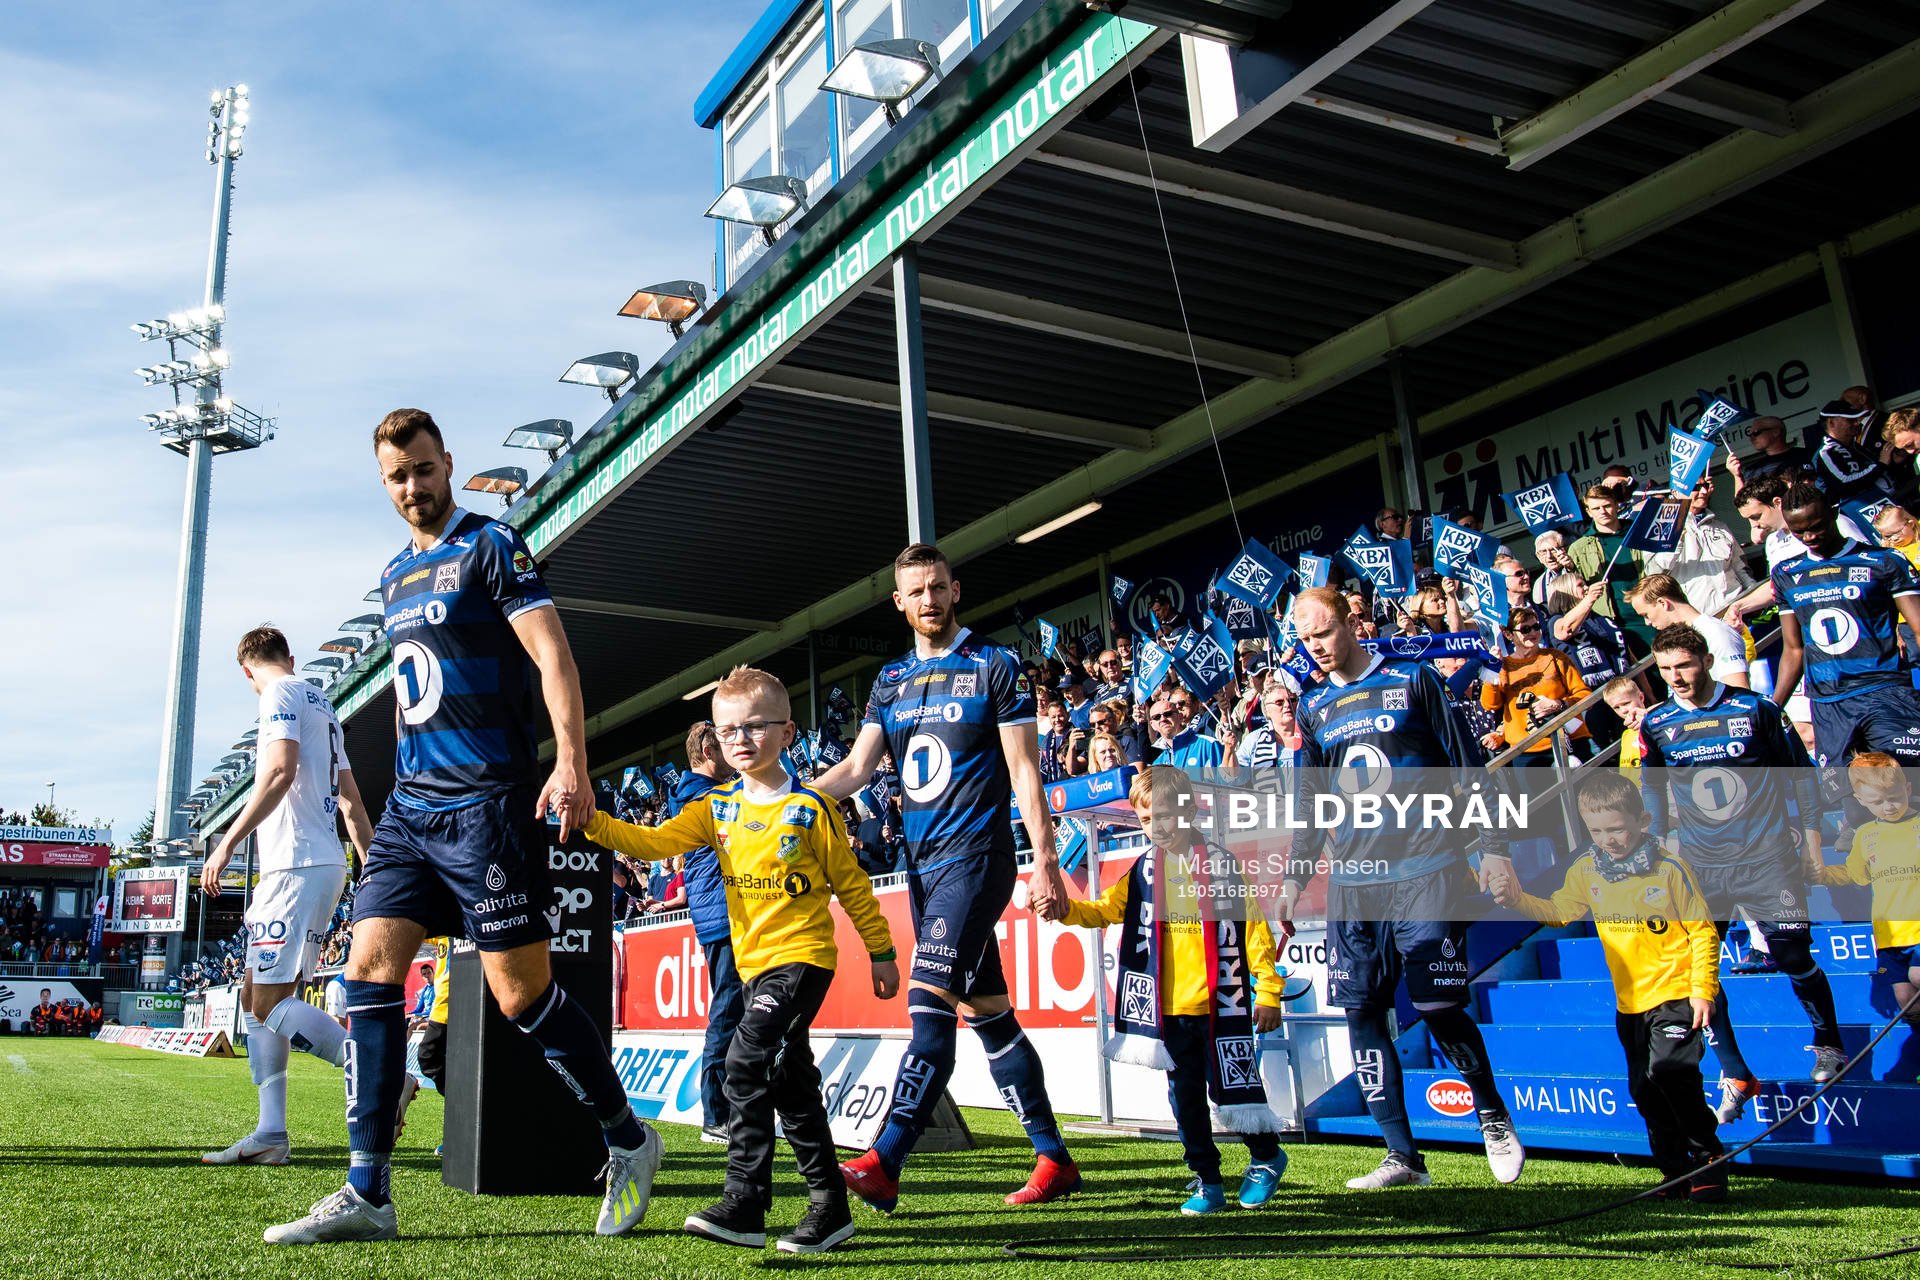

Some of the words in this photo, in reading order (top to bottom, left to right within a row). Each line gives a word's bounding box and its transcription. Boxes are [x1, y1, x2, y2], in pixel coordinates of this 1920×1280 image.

[540, 499, 573, 545] notar
[578, 462, 617, 509] notar
[621, 415, 667, 477] notar
[671, 364, 724, 435] notar
[731, 301, 793, 384] notar
[801, 228, 874, 324] notar
[886, 139, 974, 252] notar
[990, 26, 1103, 163] notar
[1516, 418, 1626, 488] Multi
[1518, 483, 1553, 507] KBK
[1658, 505, 1679, 519] KBK
[1269, 524, 1323, 554] ritime
[1443, 528, 1481, 551] KBK
[1358, 547, 1390, 565] KBK
[439, 565, 458, 578] KBK
[1230, 558, 1256, 585] KBK
[1470, 567, 1490, 587] KBK
[1793, 586, 1842, 602] SpareBank
[383, 603, 424, 631] SpareBank
[394, 618, 425, 631] NORDVEST
[1445, 637, 1484, 650] MFK
[1188, 638, 1219, 670] KBK
[270, 713, 297, 721] ISTAD
[895, 703, 943, 722] SpareBank
[914, 717, 942, 725] NDVEST
[1323, 717, 1373, 741] SpareBank
[1893, 736, 1920, 745] oliv
[1670, 742, 1725, 761] SpareBank
[1694, 753, 1727, 762] NORDVEST
[1896, 748, 1920, 756] macr
[1088, 778, 1113, 793] Varde
[78, 829, 96, 841] AS
[549, 845, 600, 872] box
[118, 868, 186, 880] MINDMAP
[721, 872, 782, 889] pareBank
[151, 894, 172, 905] BORTE
[474, 893, 529, 915] olivita
[737, 891, 784, 901] NORDVEST
[113, 920, 182, 931] MINDMAP
[482, 914, 529, 933] macron
[1162, 912, 1202, 925] eBank
[1593, 912, 1644, 926] SareBank
[250, 920, 287, 941] DO
[1608, 926, 1645, 934] NORDVEST
[549, 929, 592, 953] ECT
[915, 942, 958, 959] olivita
[916, 958, 953, 973] macron
[1, 1005, 21, 1017] Sea
[137, 997, 182, 1009] recon
[612, 1046, 690, 1095] DRIFT
[818, 1071, 888, 1131] skap
[1429, 1088, 1474, 1106] GJØCO
[1514, 1086, 1617, 1115] MALING
[1754, 1094, 1870, 1127] EPOXY
